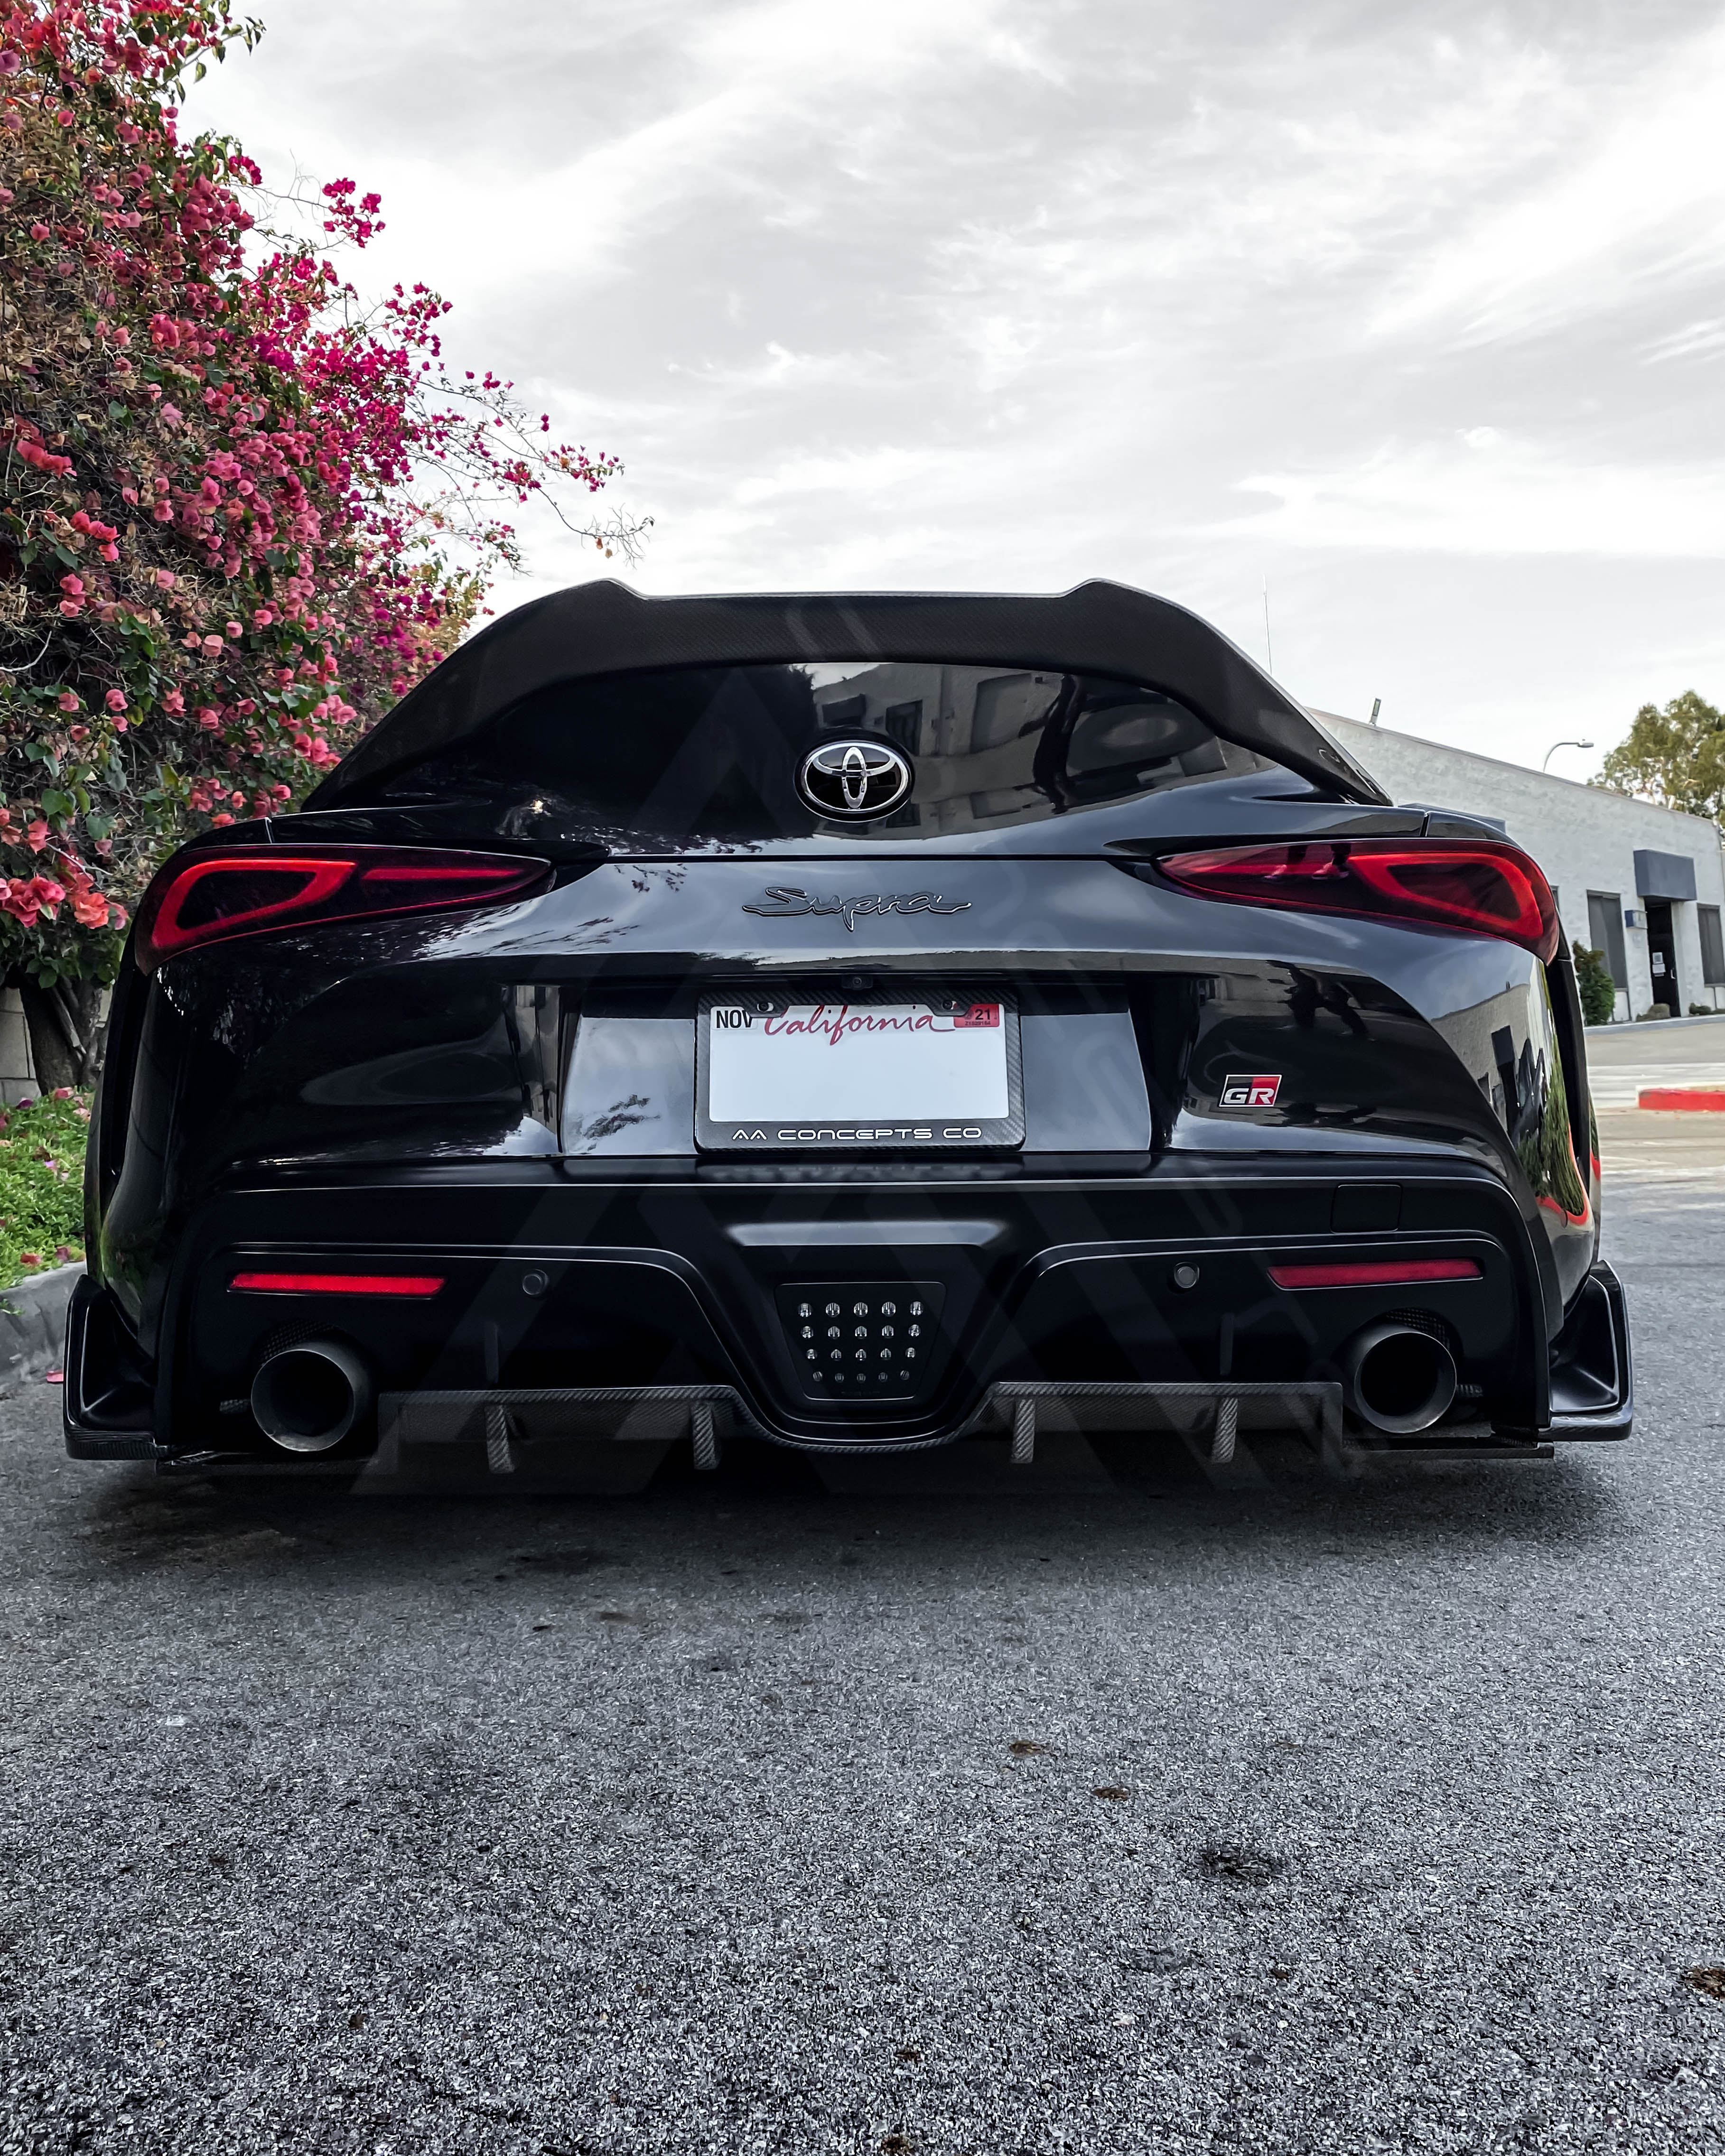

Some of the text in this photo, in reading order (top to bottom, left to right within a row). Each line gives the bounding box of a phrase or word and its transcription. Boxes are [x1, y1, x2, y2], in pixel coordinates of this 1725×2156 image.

[742, 886, 971, 932] Supra
[716, 1009, 753, 1029] NOV
[975, 1008, 990, 1021] 21
[765, 1004, 956, 1046] California
[1224, 1088, 1275, 1104] GR
[732, 1127, 982, 1140] AA CONCEPTS CO
